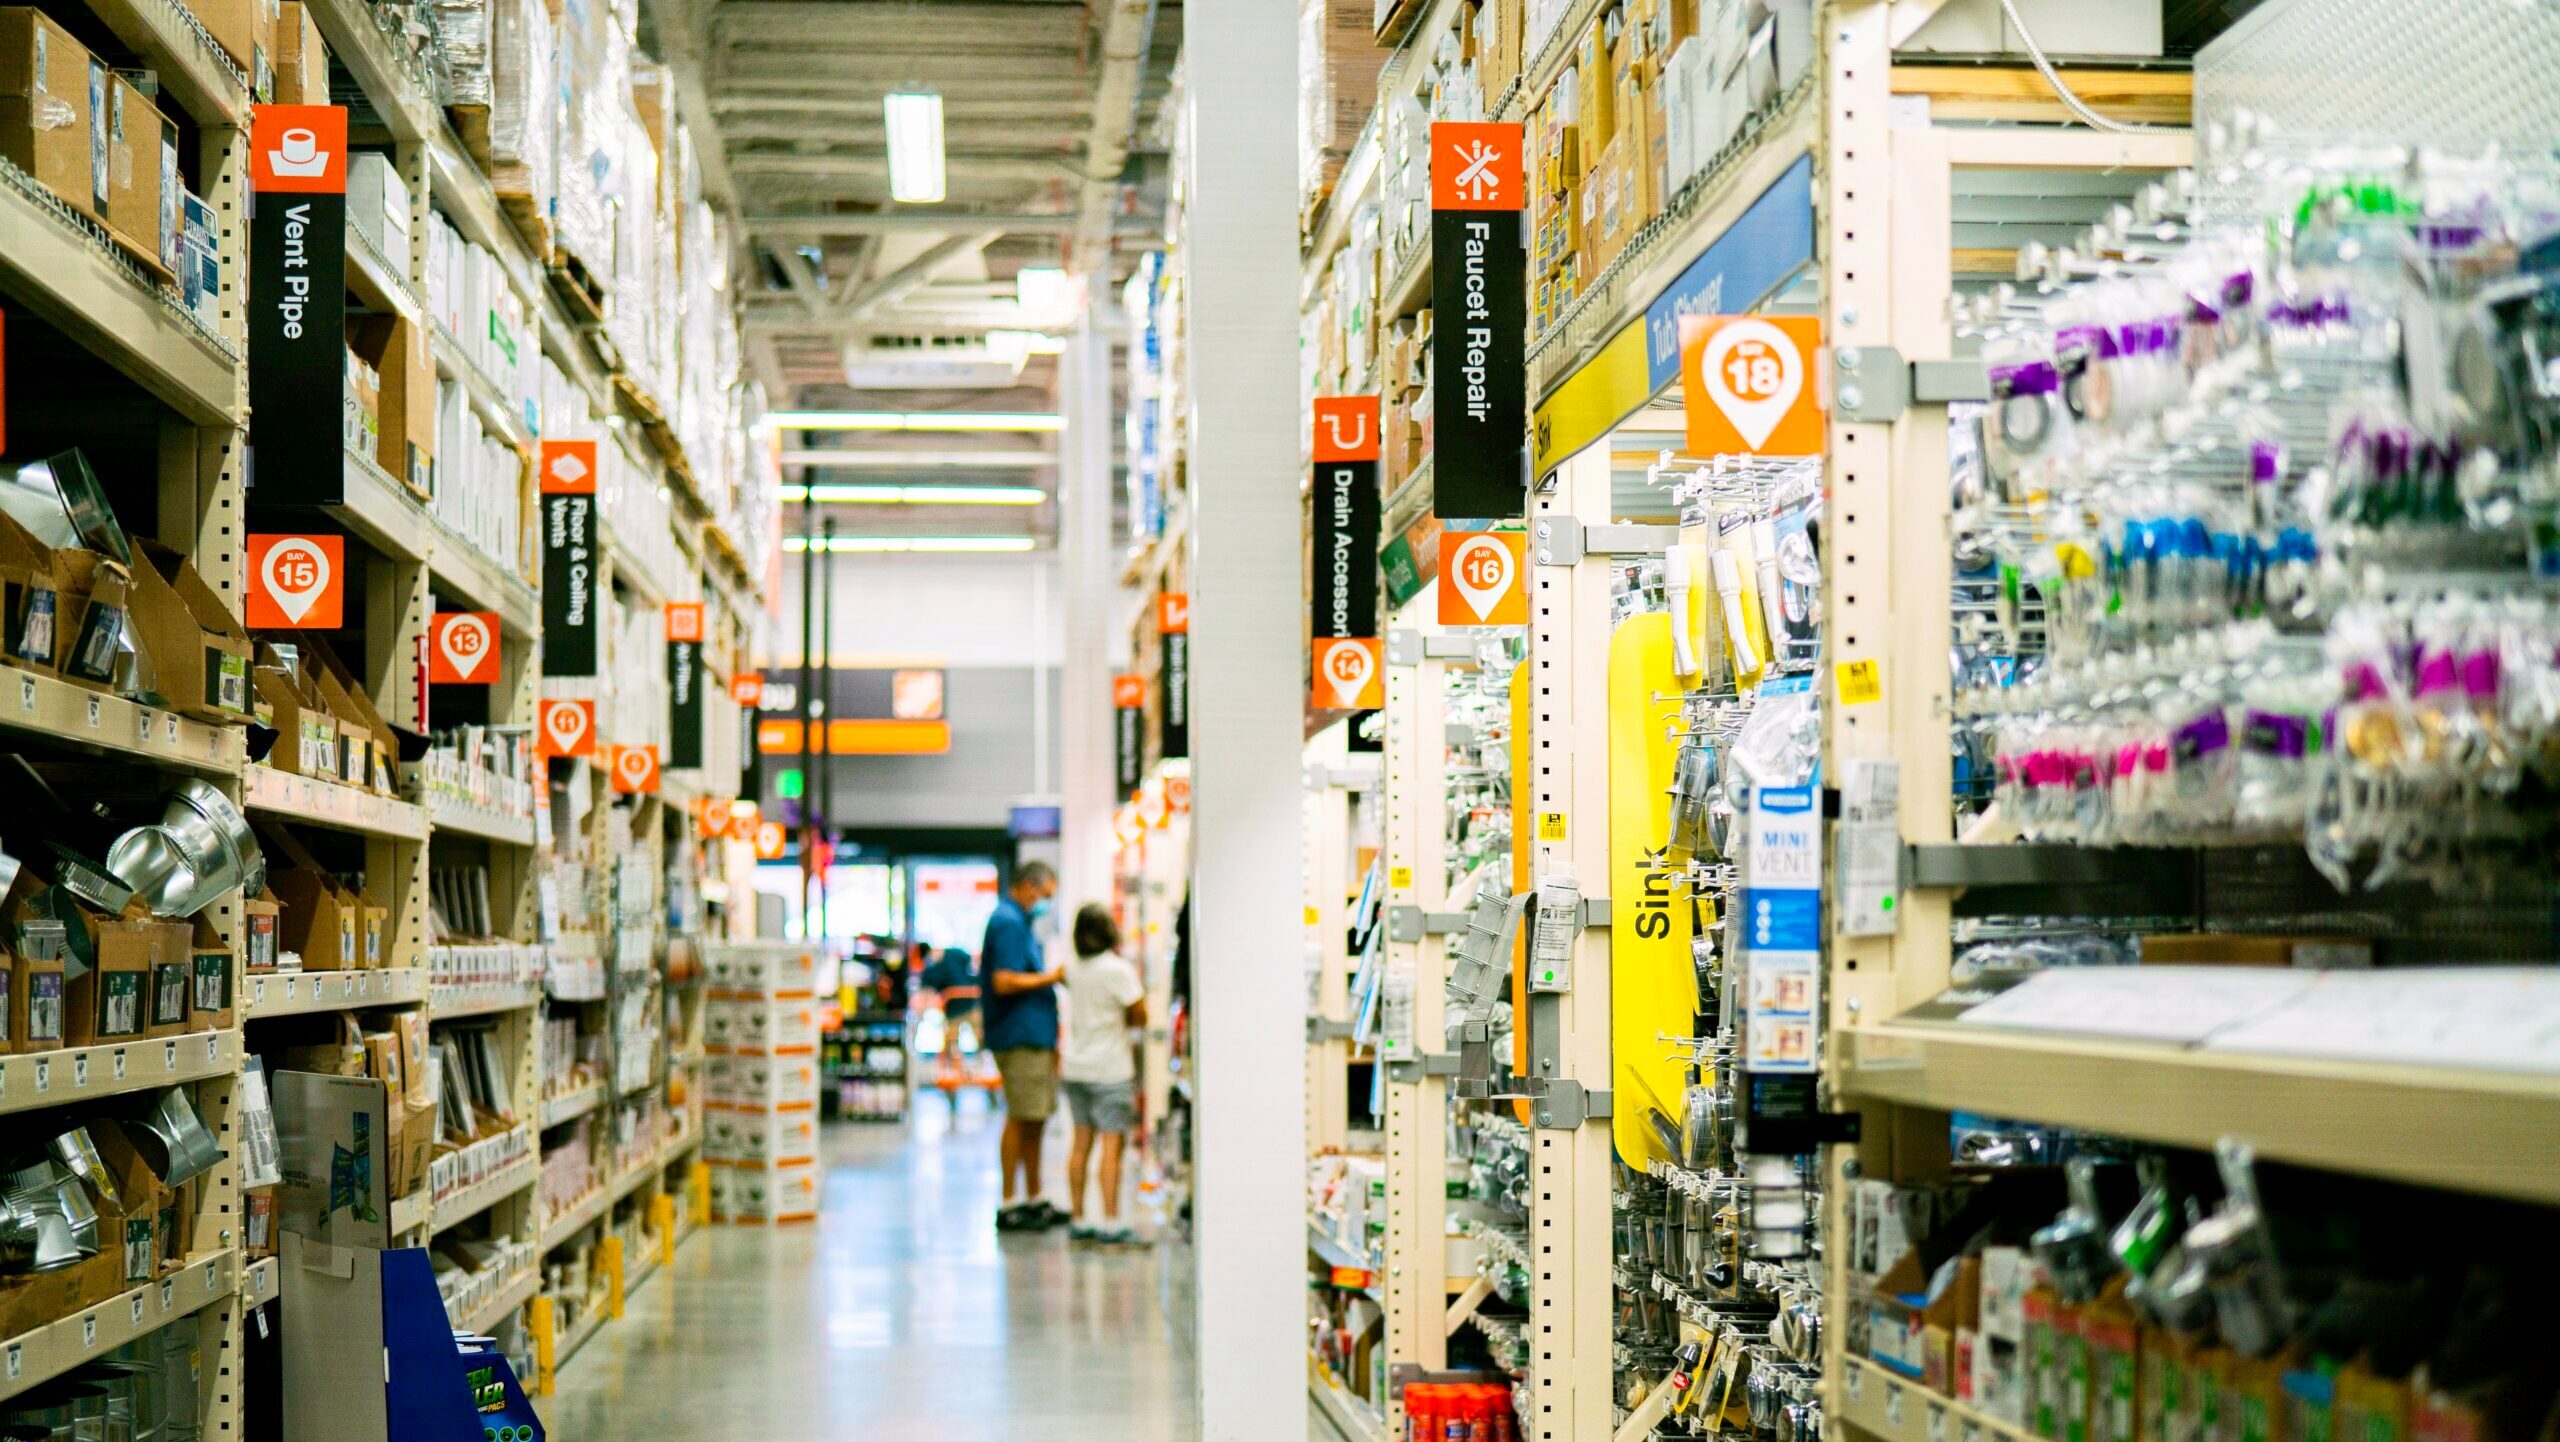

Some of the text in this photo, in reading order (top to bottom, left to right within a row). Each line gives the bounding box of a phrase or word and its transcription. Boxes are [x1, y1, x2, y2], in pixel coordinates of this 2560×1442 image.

[278, 203, 311, 339] Vent Pipe
[1461, 222, 1492, 423] Faucet Repair
[1726, 357, 1781, 395] 18
[550, 498, 568, 549] Vents
[286, 552, 305, 561] BAY
[566, 497, 589, 626] Floor & Ceiling
[1332, 469, 1354, 638] Drain Accessori
[1474, 549, 1492, 558] BAY
[279, 562, 315, 588] 15
[1467, 559, 1500, 584] 16
[453, 633, 480, 653] 13
[1336, 658, 1361, 677] 14
[557, 716, 575, 732] 11
[1763, 831, 1808, 849] MINI
[1756, 850, 1814, 873] VENT
[1635, 845, 1670, 940] Sink
[473, 1381, 506, 1404] LER
[487, 1400, 507, 1413] PACS
